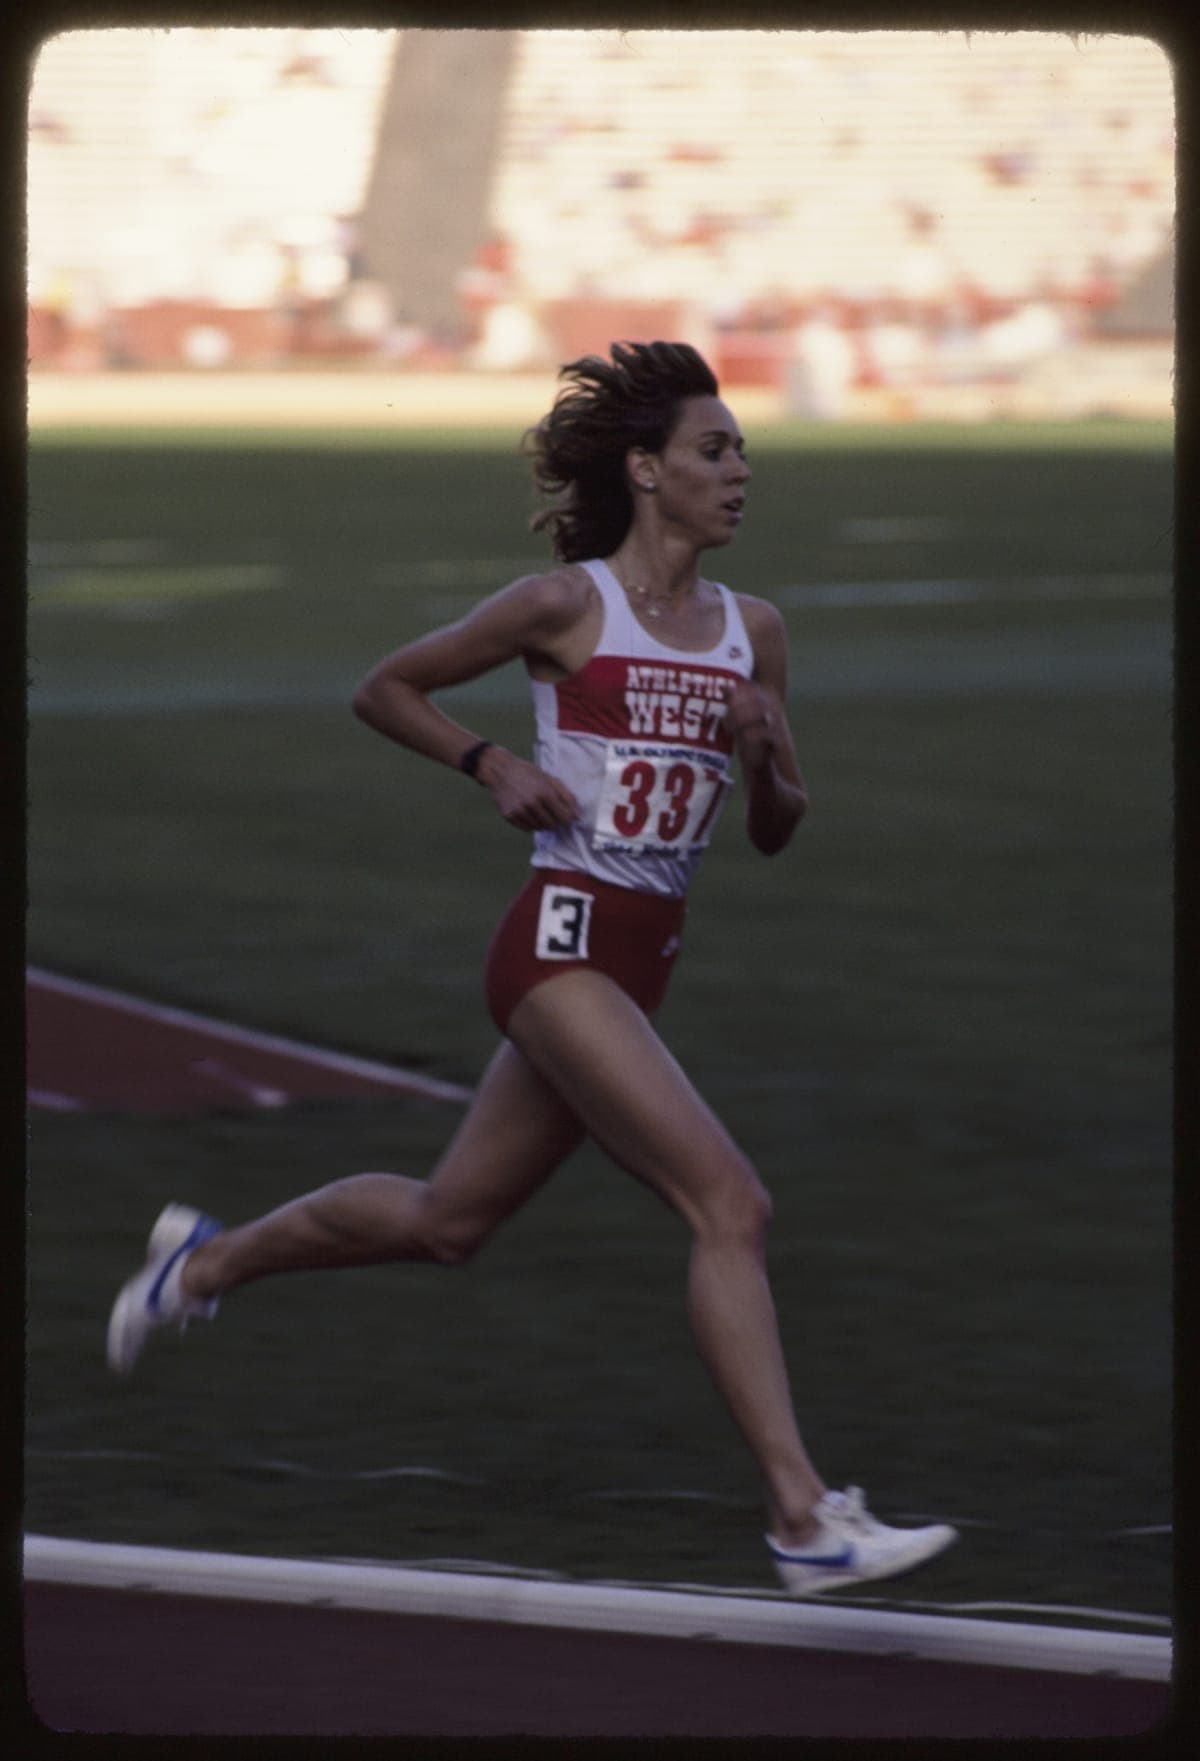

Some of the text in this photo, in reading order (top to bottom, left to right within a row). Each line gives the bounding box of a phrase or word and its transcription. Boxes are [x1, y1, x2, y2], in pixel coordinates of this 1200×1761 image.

[626, 665, 737, 699] ATHLETIC
[624, 691, 728, 742] WEST
[548, 895, 585, 955] 3
